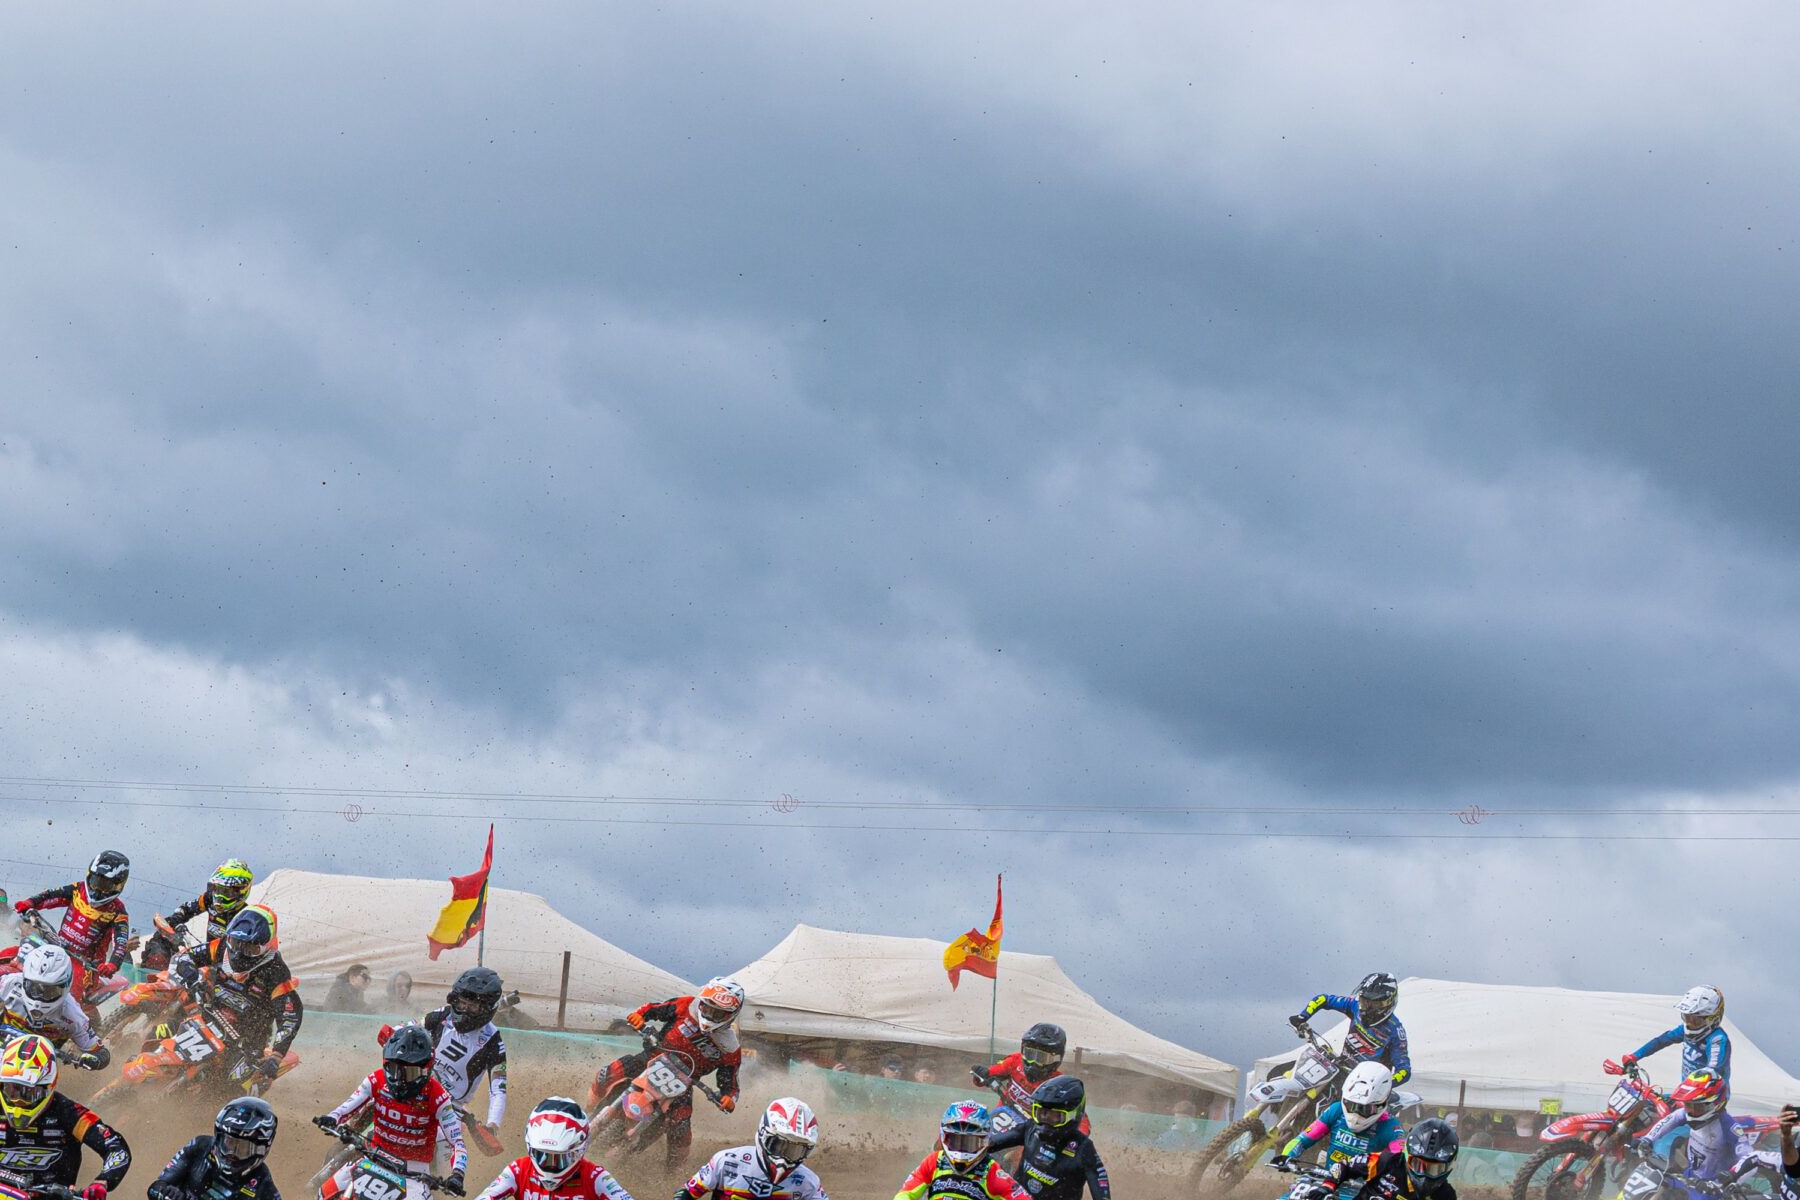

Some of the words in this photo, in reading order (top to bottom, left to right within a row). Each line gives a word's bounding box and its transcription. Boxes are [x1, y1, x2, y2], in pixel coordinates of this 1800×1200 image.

[647, 1060, 688, 1096] 199
[1296, 1058, 1329, 1085] 19
[375, 1101, 430, 1126] MOTS
[374, 1126, 429, 1147] GASGAS
[1335, 1130, 1369, 1150] MOTS
[0, 1148, 61, 1166] TRT
[370, 1164, 404, 1187] MOTOREX
[1623, 1173, 1658, 1197] 27
